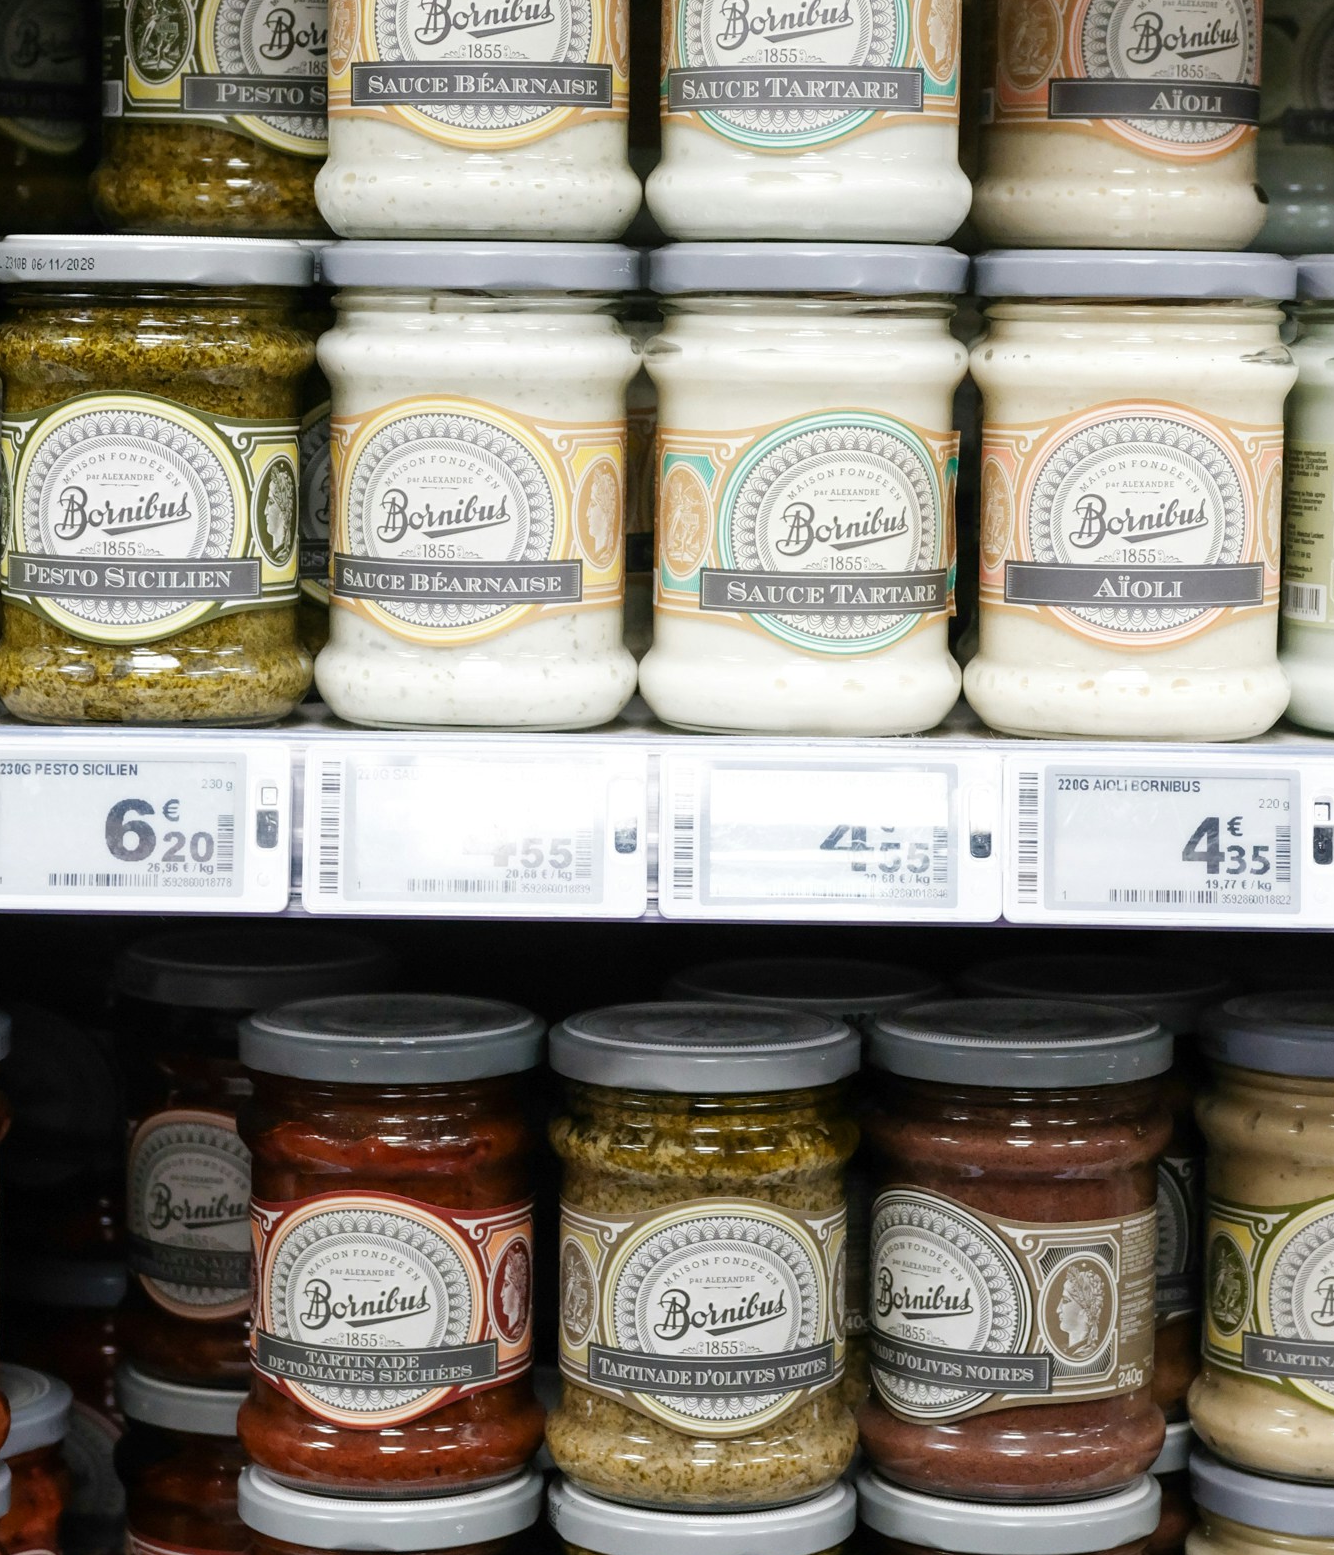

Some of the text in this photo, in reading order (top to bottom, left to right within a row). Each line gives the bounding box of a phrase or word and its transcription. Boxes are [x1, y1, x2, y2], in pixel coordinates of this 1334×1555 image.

[368, 70, 597, 96] SAUCE BÉARNAISE
[683, 76, 898, 100] SAUCE TARTARE
[1094, 575, 1183, 599] AÏOLI
[0, 763, 138, 777] 230G PESTO SICILIEN
[305, 1353, 419, 1369] TARTINADE
[896, 1349, 1034, 1383] D'OLIVES NOIRES
